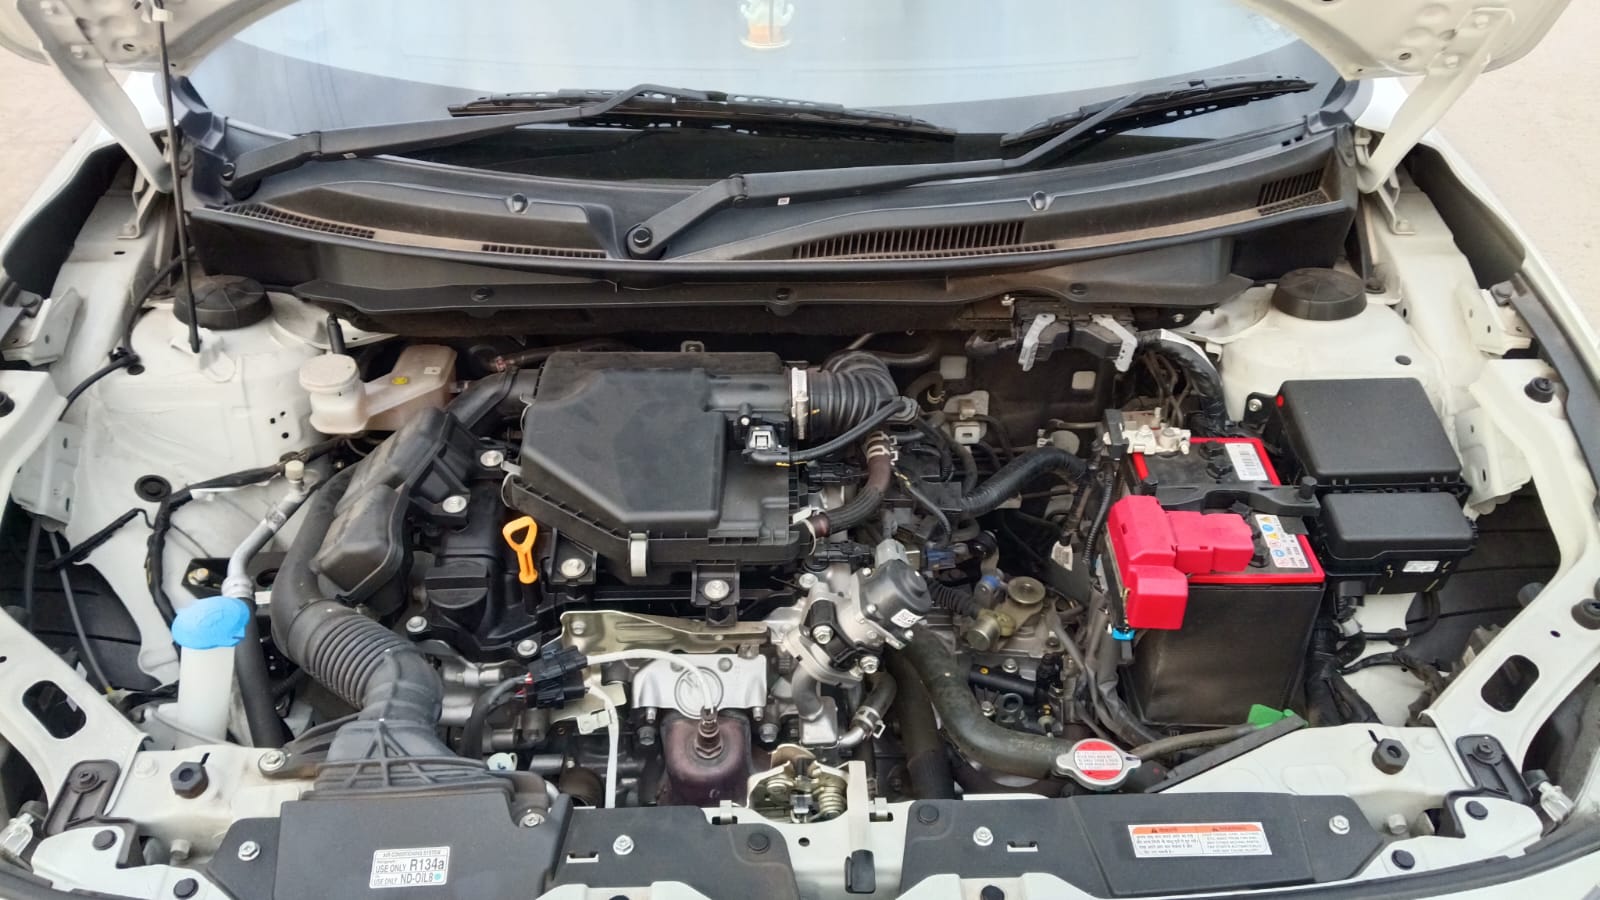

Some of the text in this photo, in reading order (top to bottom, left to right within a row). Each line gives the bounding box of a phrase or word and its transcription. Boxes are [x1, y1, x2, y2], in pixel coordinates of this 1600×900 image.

[376, 857, 445, 873] USE ONLY R134a
[374, 878, 385, 886] USE
[385, 877, 398, 885] ONLY
